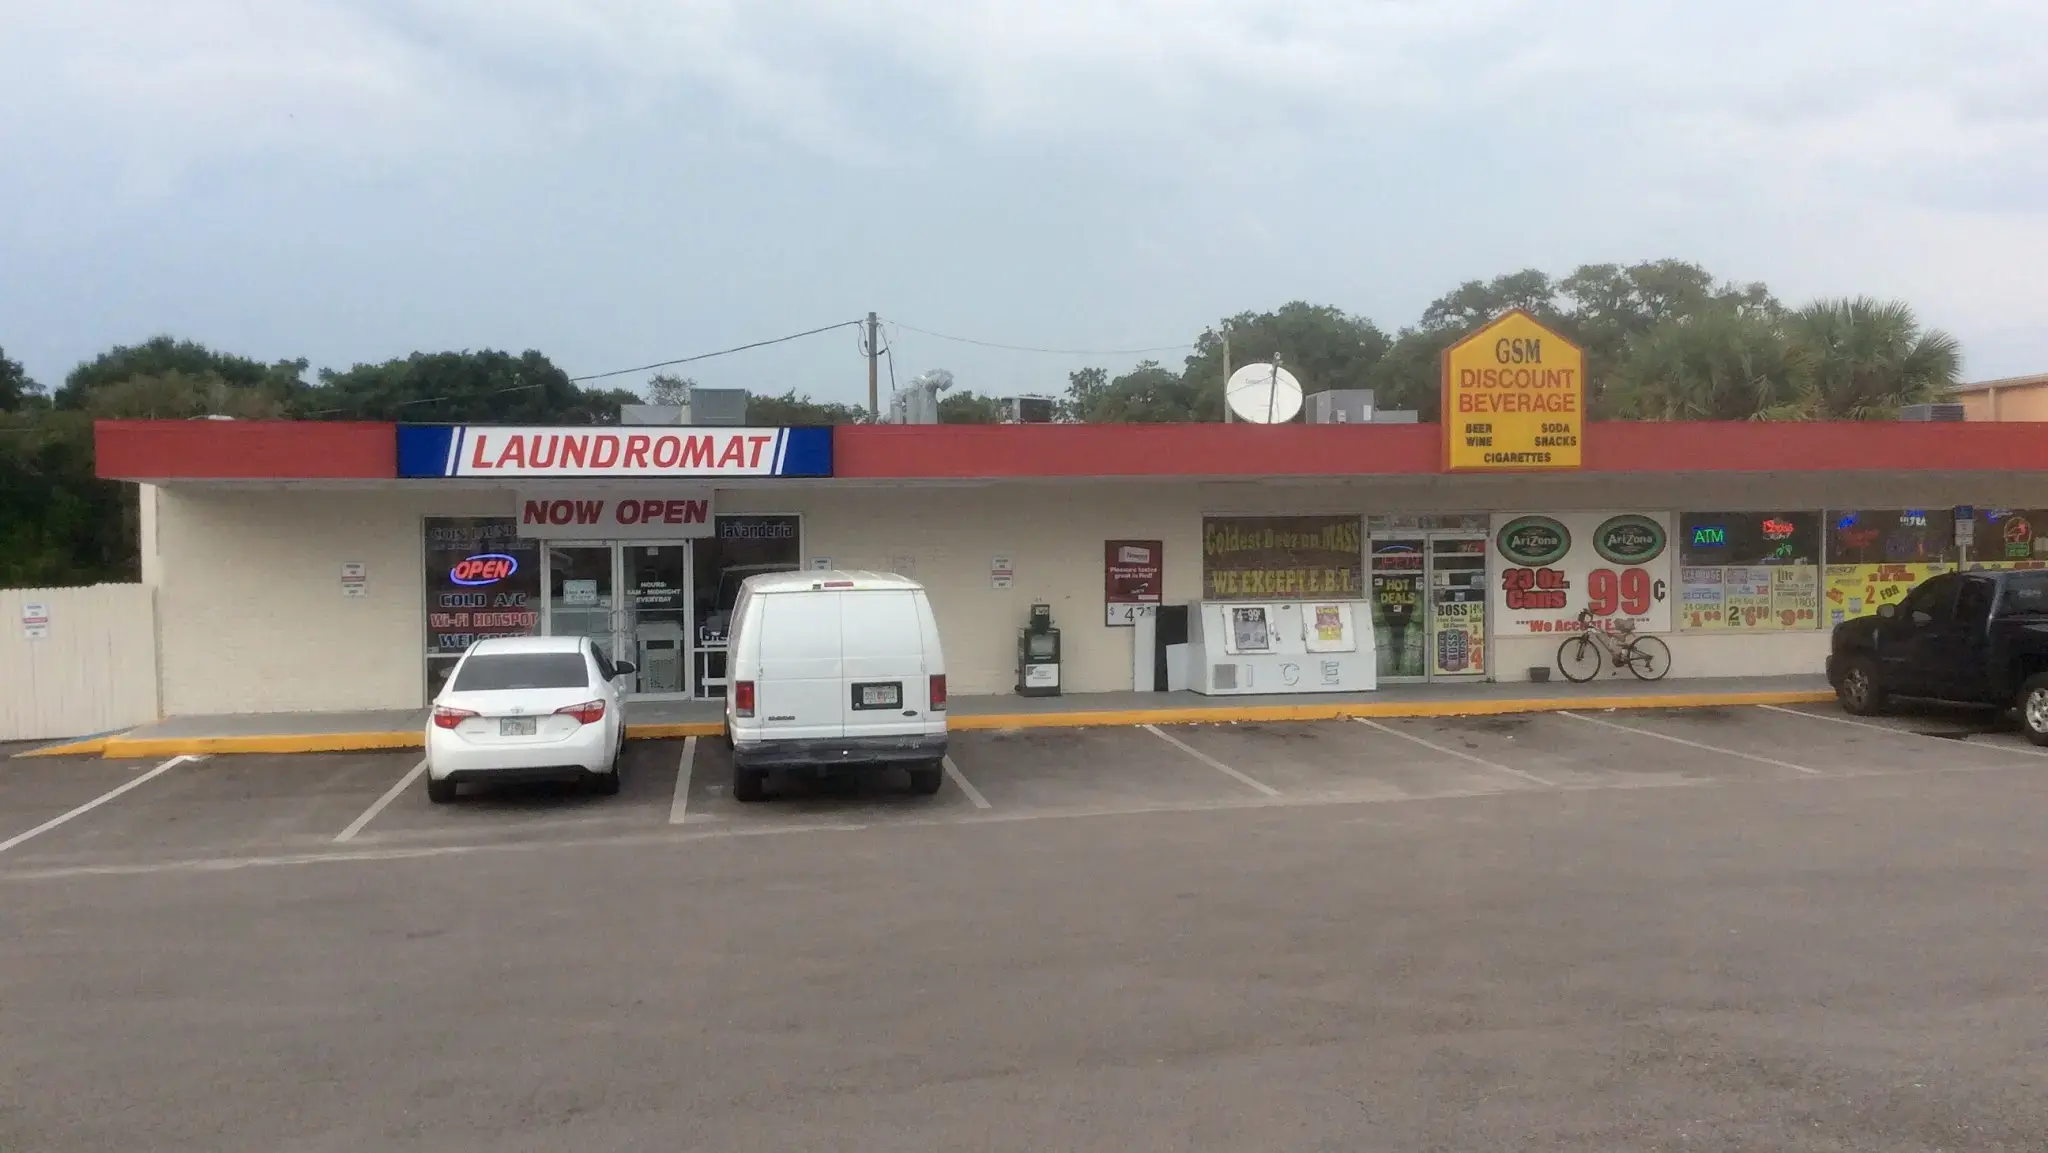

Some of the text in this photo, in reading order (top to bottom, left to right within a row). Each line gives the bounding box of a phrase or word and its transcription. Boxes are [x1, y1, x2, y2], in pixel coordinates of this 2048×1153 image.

[1495, 338, 1541, 364] GSM
[1460, 368, 1575, 388] DISCOUNT
[1459, 393, 1576, 413] BEVERAGE
[1465, 424, 1492, 433] BEER
[1541, 423, 1570, 433] SODA
[1466, 436, 1492, 446] WINE
[1535, 436, 1577, 446] SNACKS
[471, 435, 771, 469] LAUNDROMAT
[1484, 452, 1551, 462] CIGARETTES
[523, 500, 707, 525] NOW OPEN
[721, 521, 793, 539] lavanderia
[1206, 522, 1260, 555] Coldest
[1694, 529, 1724, 544] ATM
[455, 561, 509, 579] OPEN
[1502, 568, 1535, 590] 23
[1212, 571, 1238, 593] WE
[1241, 570, 1306, 593] EXCEPT
[1386, 579, 1410, 592] HOT
[440, 593, 487, 608] COLD
[1381, 592, 1416, 604] DEALS
[1506, 589, 1566, 609] Cans
[1865, 584, 1901, 604] 2 FOR
[1437, 603, 1468, 617] BOSS
[1728, 605, 1740, 620] 2
[430, 611, 537, 630] Wi-Fi HOTSPOT
